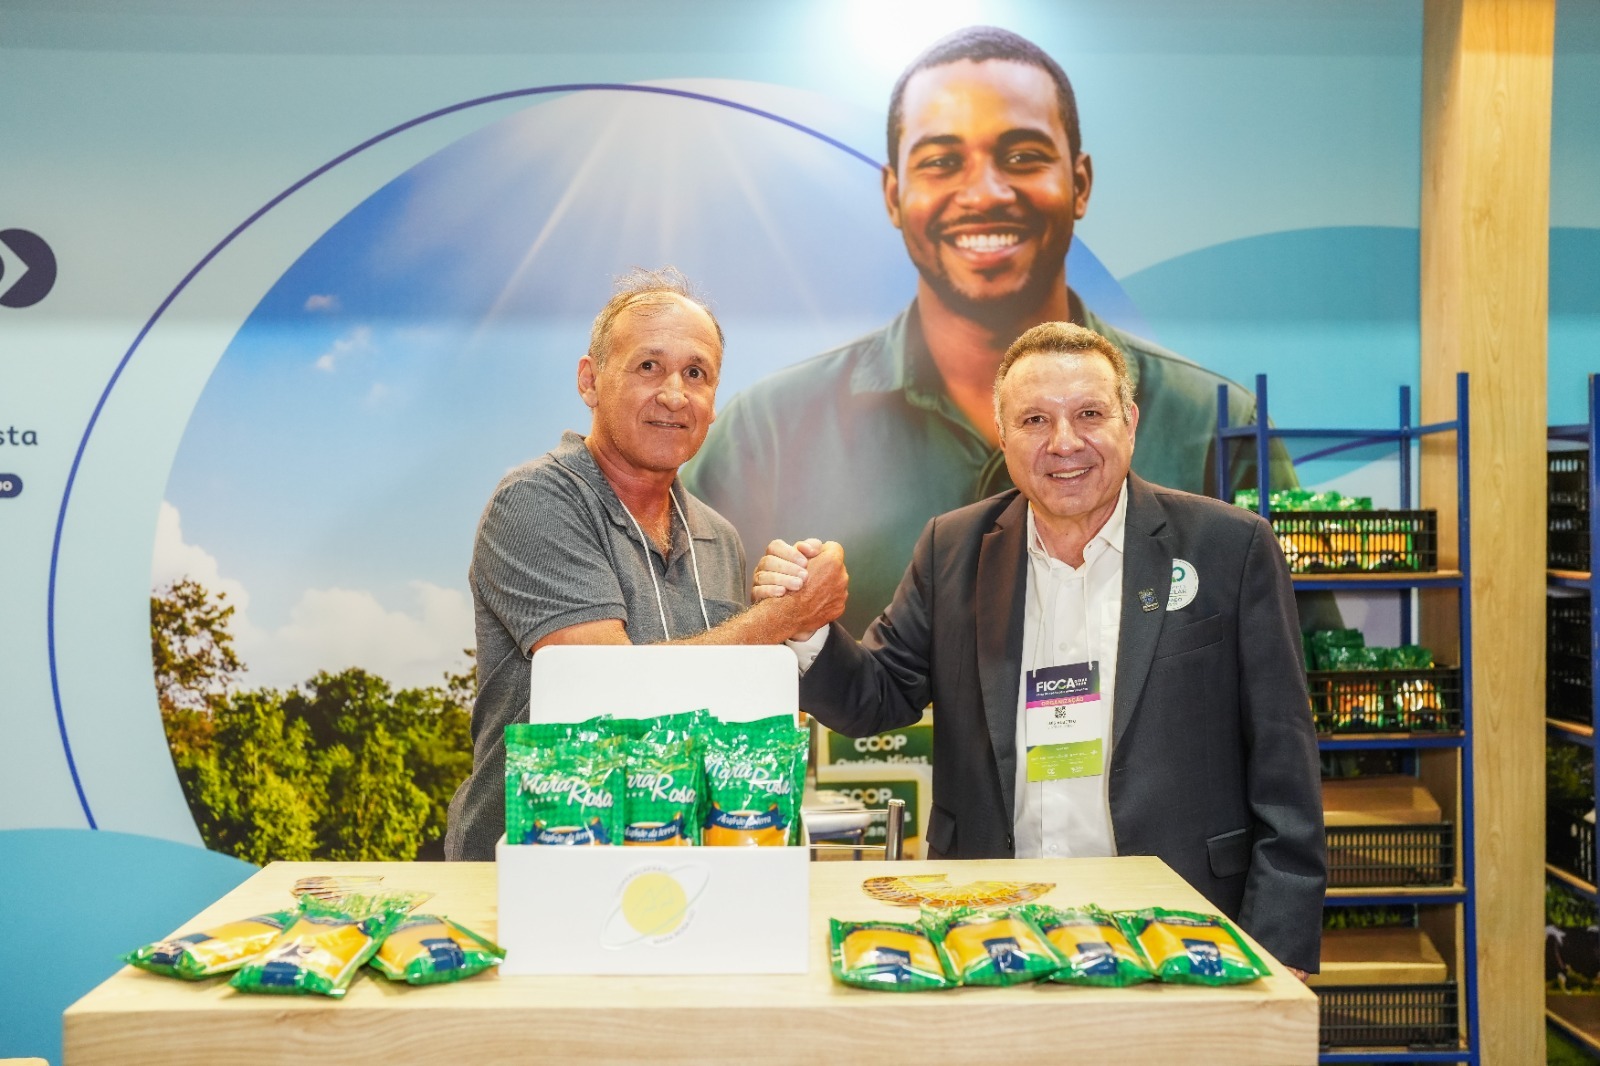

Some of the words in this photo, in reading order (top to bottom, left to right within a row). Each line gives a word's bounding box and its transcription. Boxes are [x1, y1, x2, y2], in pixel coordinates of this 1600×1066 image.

[1036, 678, 1076, 693] FICCA
[854, 734, 908, 752] COOP
[650, 773, 697, 804] Rosa
